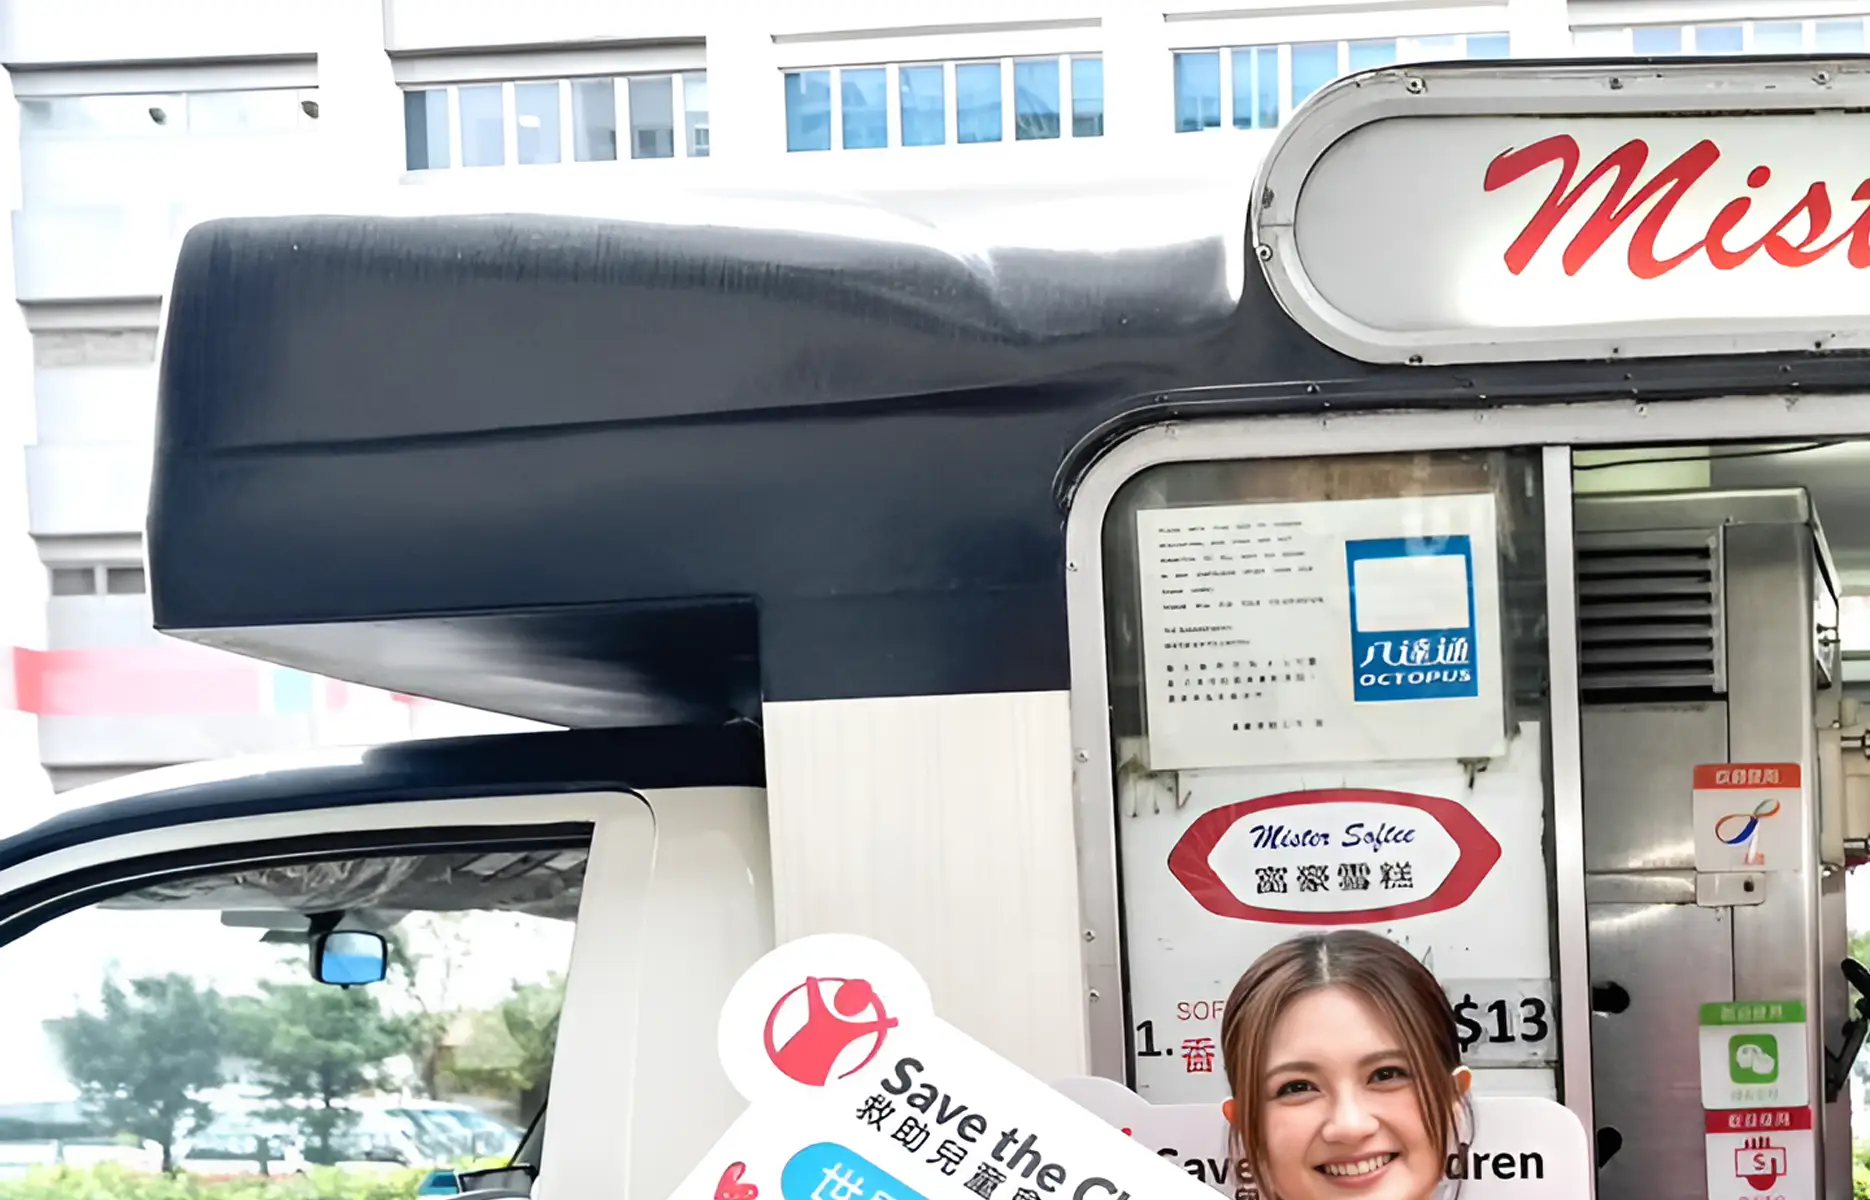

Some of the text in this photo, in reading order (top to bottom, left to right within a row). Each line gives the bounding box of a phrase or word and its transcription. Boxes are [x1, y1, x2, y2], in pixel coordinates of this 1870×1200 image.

[1359, 668, 1471, 686] OCTOPUS
[1454, 993, 1549, 1054] $13
[880, 1056, 988, 1144] Save
[990, 1127, 1067, 1193] the
[1157, 1148, 1253, 1184] ave
